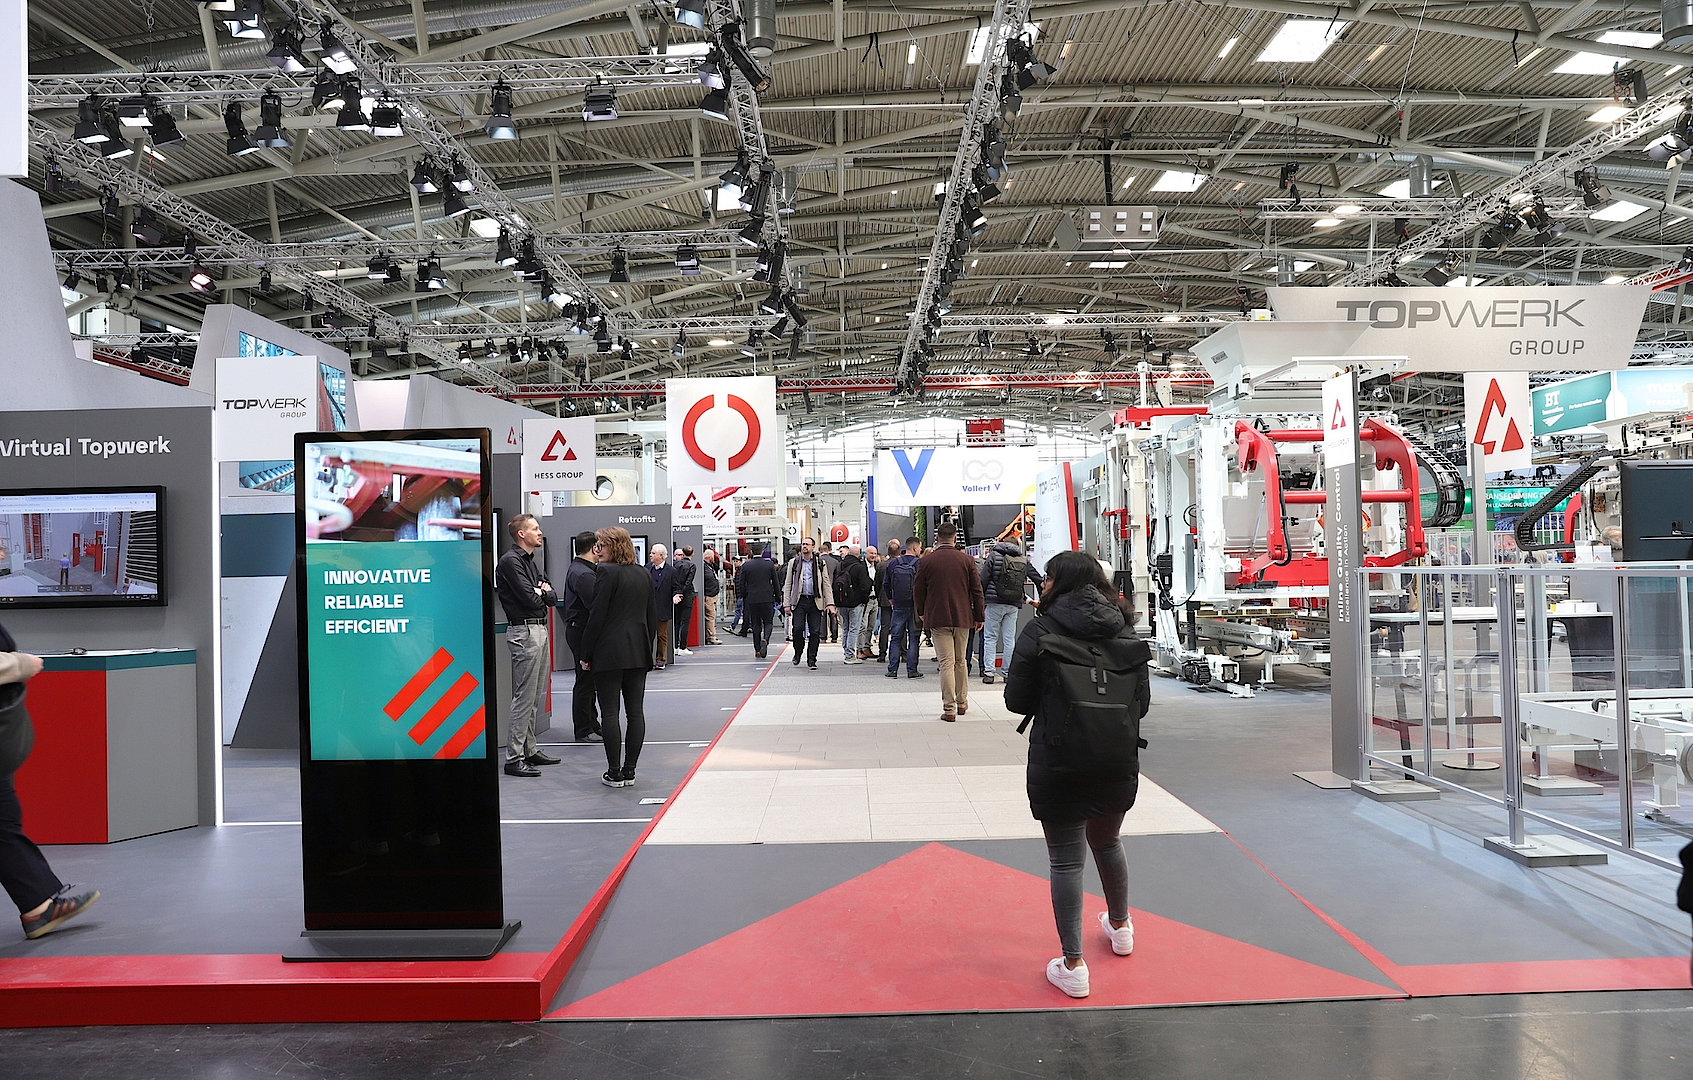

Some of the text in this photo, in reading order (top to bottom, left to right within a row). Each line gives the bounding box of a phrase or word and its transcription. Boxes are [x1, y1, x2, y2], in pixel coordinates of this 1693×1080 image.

[1336, 299, 1586, 328] TOPWERK
[1509, 339, 1585, 355] GROUP
[223, 397, 307, 410] TOPWERK
[0, 435, 171, 459] Virtual Topwerk
[555, 471, 584, 479] GROUP
[962, 484, 991, 492] Vollert
[618, 515, 656, 524] Retrofits
[324, 568, 431, 585] INNOVATIVE
[324, 594, 404, 610] RELIABLE
[325, 618, 410, 634] EFFICIENT
